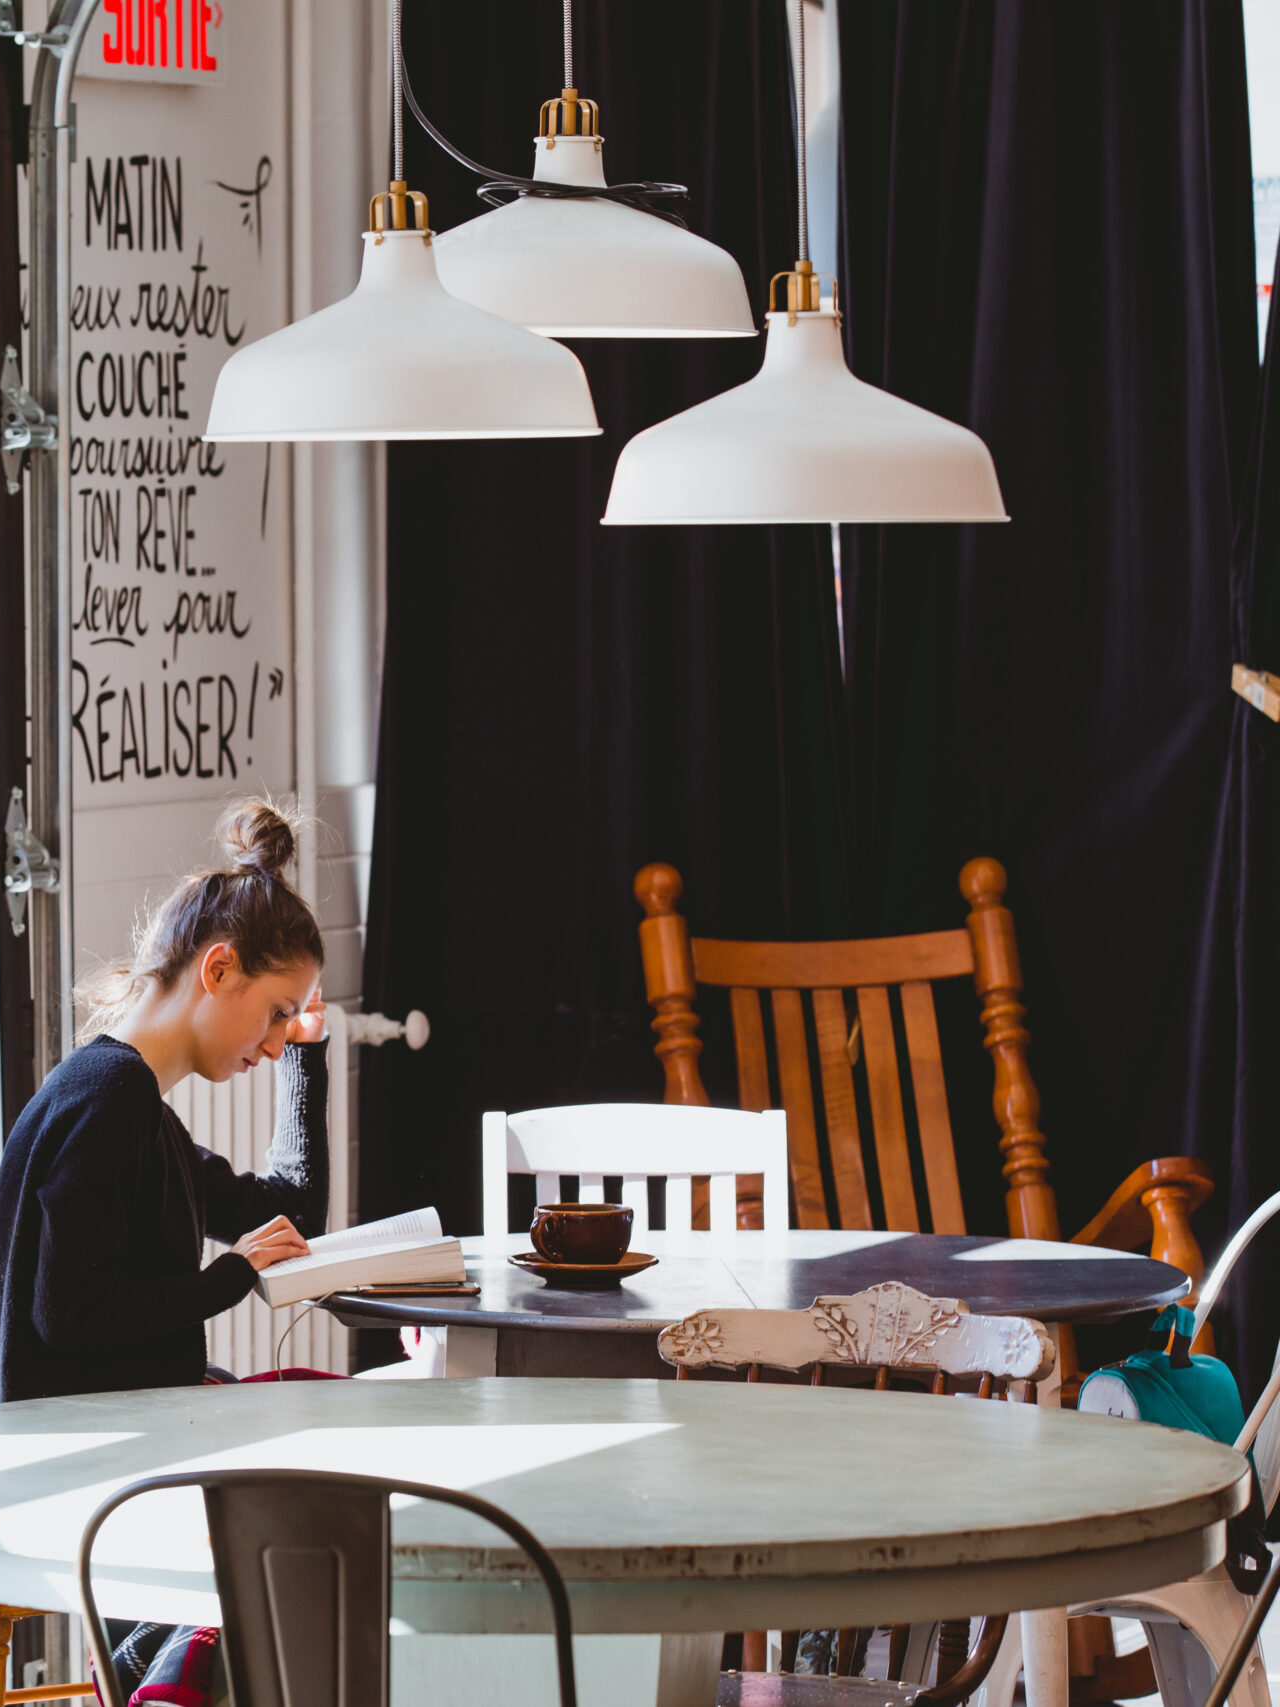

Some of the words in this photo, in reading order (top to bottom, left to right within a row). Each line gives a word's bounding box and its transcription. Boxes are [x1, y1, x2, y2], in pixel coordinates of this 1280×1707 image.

[103, 0, 217, 71] SORTIE
[86, 155, 183, 251] MATIN
[130, 236, 247, 346] rester
[76, 344, 190, 421] COUCHÉ
[70, 424, 227, 479] poursuivre
[78, 488, 120, 564] TON
[72, 563, 149, 637] lever
[163, 588, 252, 663] pour
